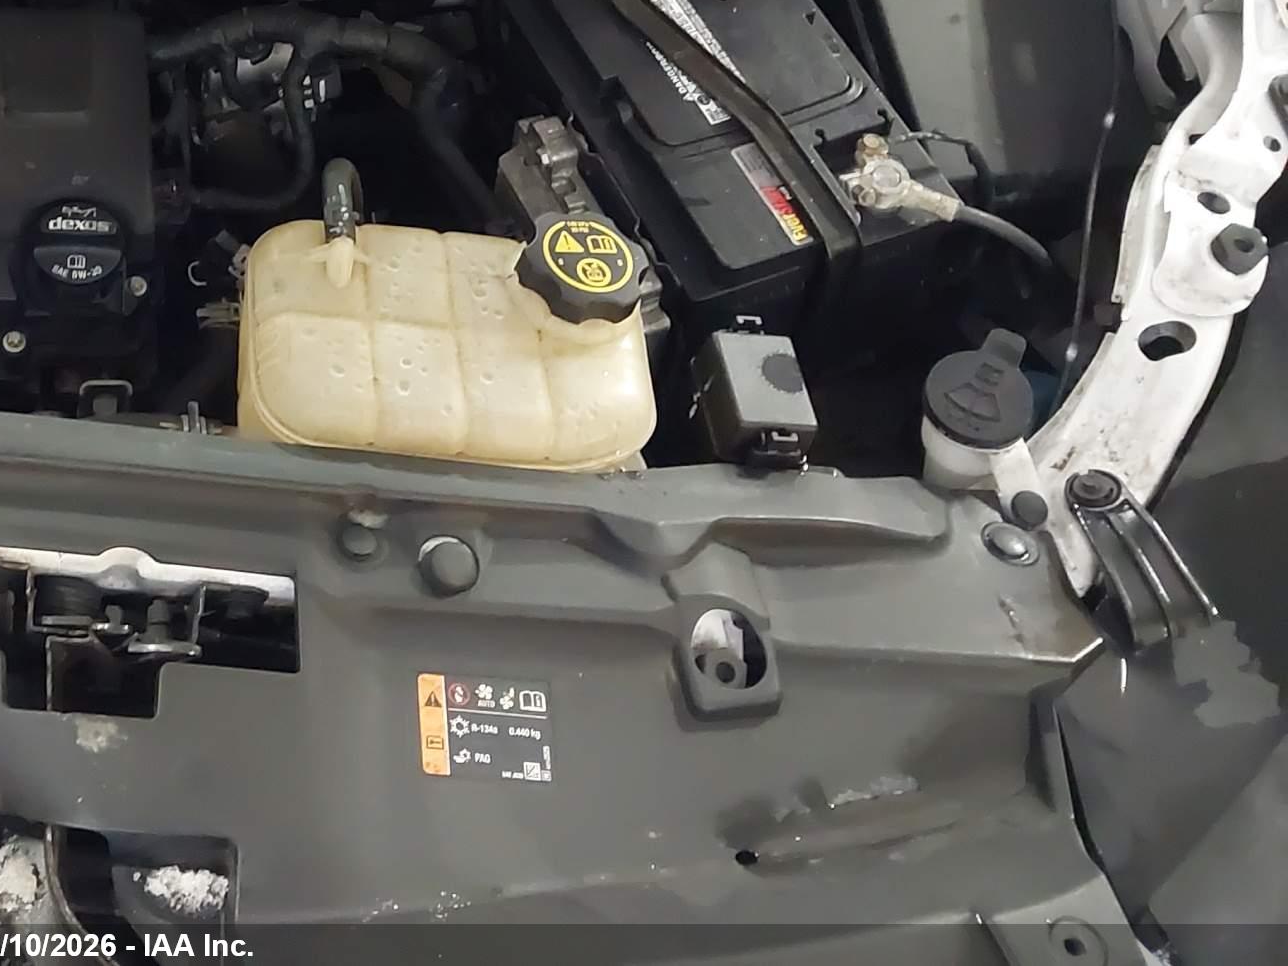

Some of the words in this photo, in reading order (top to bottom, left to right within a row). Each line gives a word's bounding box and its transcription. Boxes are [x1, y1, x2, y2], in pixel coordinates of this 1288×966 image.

[48, 216, 113, 233] dexos
[470, 723, 499, 735] R-134a
[530, 728, 542, 740] kg
